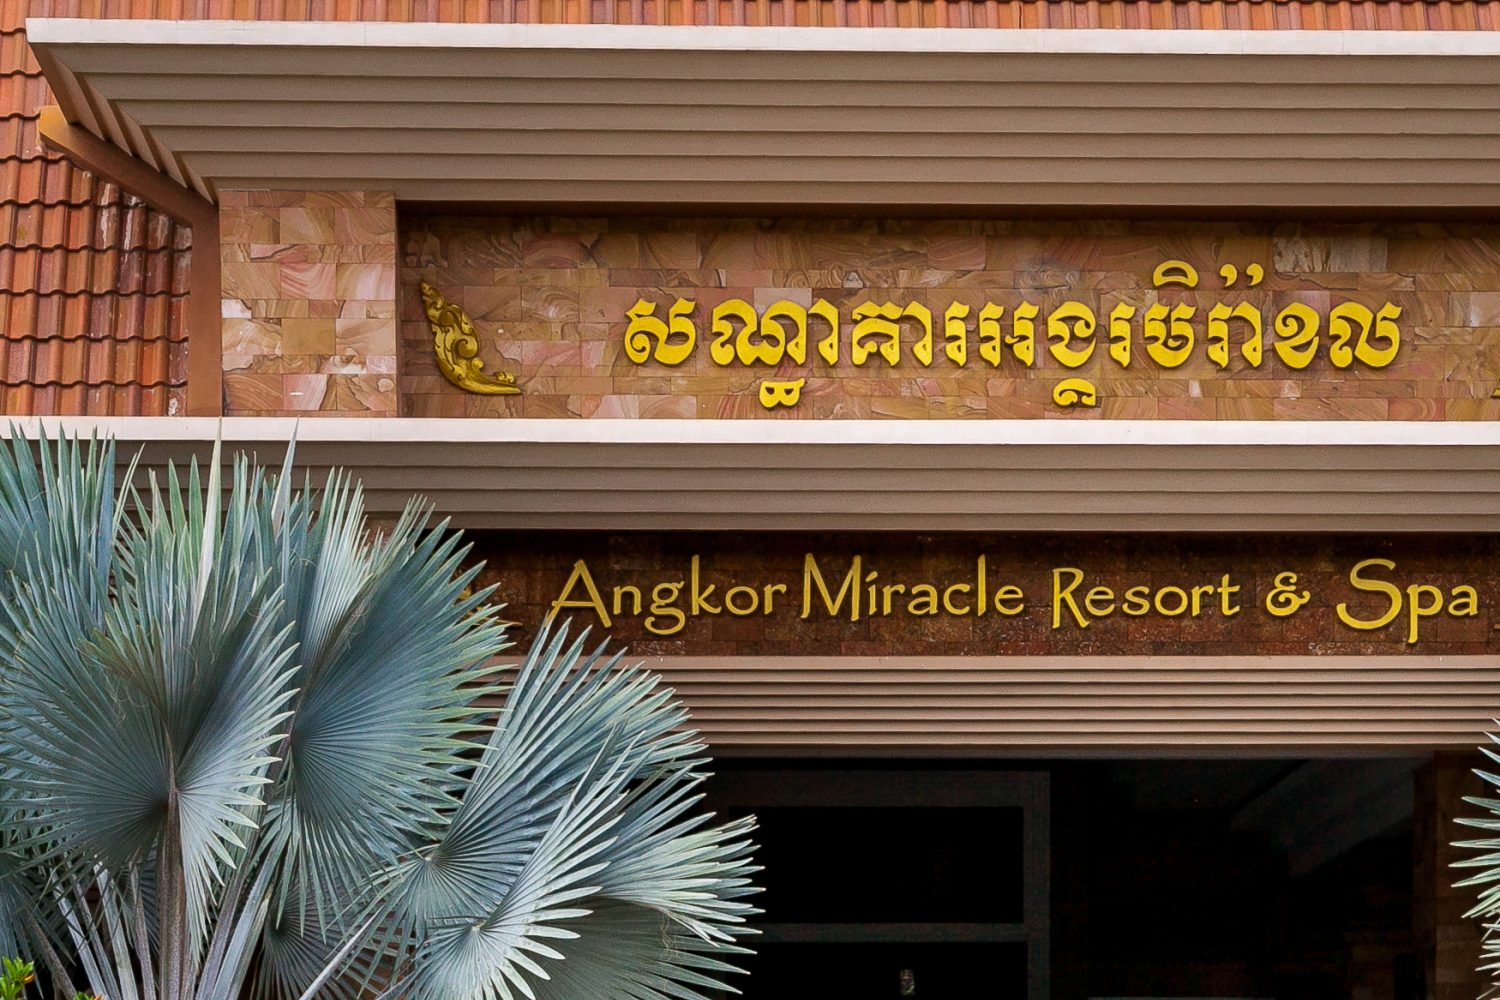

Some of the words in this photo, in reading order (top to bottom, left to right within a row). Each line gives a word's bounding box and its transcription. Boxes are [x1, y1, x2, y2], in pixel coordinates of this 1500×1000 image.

[547, 553, 788, 636] Angkor
[800, 552, 1026, 622] Miracle
[1051, 566, 1242, 630] Resort
[1265, 570, 1311, 618] &
[1335, 557, 1480, 645] Spa
